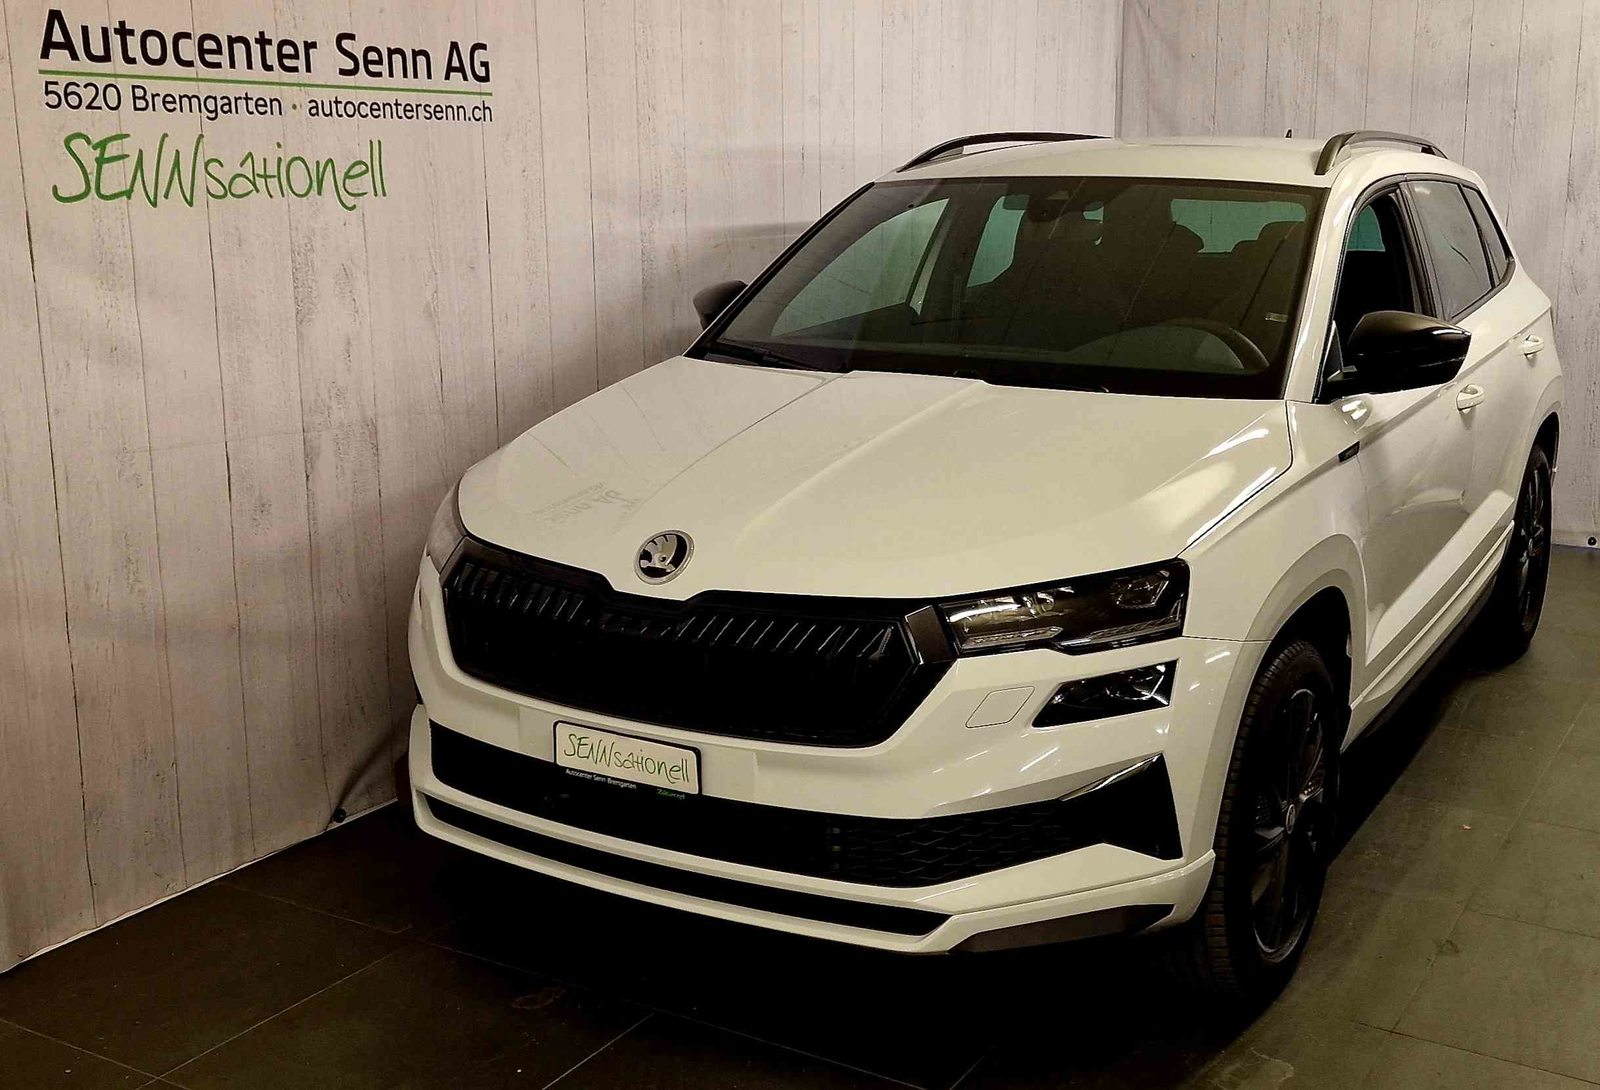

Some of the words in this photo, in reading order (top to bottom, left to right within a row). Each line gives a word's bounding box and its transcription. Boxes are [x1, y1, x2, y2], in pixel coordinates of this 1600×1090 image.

[40, 9, 317, 75] Autocenter
[335, 33, 432, 80] Senn
[444, 41, 491, 83] AG
[43, 80, 122, 111] 5620
[132, 84, 282, 121] Bremgarten
[308, 97, 493, 122] autocentersenn.ch
[52, 132, 387, 211] SENNsationell
[564, 733, 690, 784] SENNsationell
